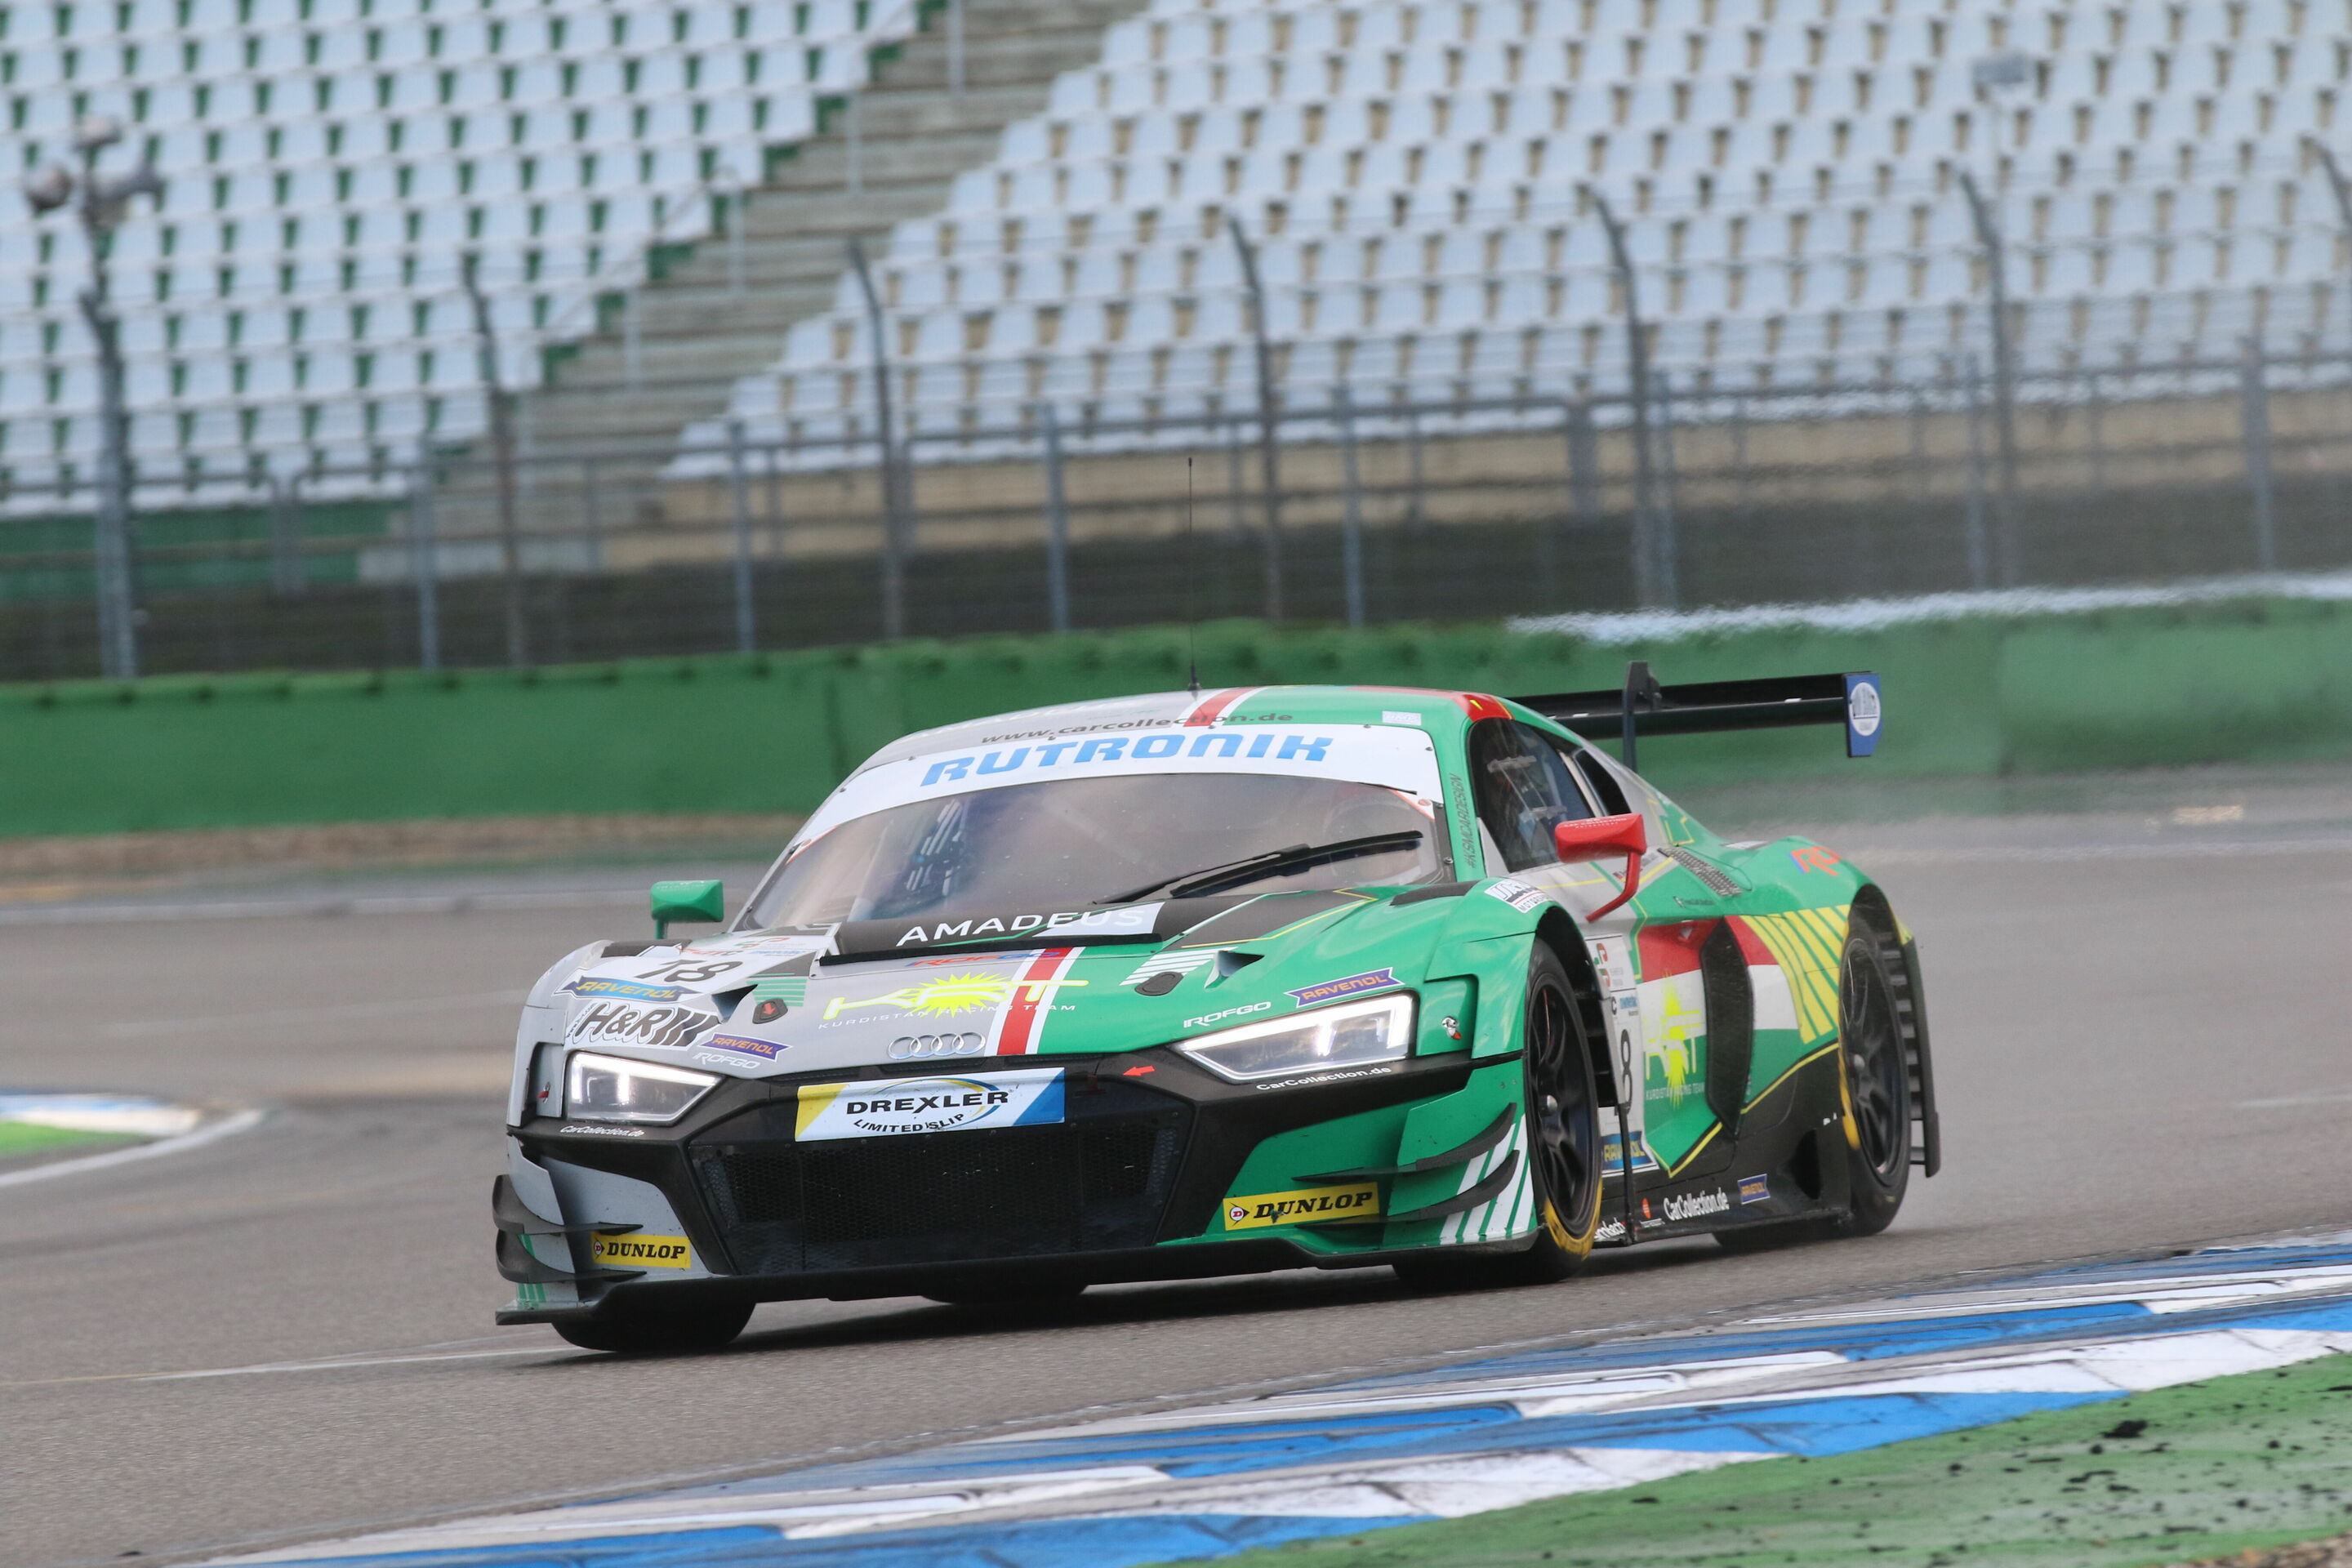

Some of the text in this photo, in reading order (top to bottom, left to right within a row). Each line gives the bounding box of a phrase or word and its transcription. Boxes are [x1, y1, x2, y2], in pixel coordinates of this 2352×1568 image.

[981, 712, 1293, 743] www.carcollection.de
[920, 733, 1333, 786] RUTRONIK
[896, 906, 1146, 947] AMADEUS
[635, 959, 743, 983] 18
[905, 951, 1062, 967] ROFGO
[575, 981, 678, 1000] RAVENOL
[1301, 974, 1388, 1001] RAVENOL
[573, 1002, 675, 1041] H&R
[818, 1009, 932, 1030] KURDISTAN
[941, 1004, 1013, 1015] RACING
[1183, 1001, 1272, 1028] ROFGO
[712, 1036, 775, 1055] RAVENOL
[693, 1052, 761, 1069] ROFGO
[1256, 1066, 1392, 1090] CarCollection.de
[846, 1090, 1009, 1115] DREXLER
[559, 1125, 645, 1138] CarCollection.de
[853, 1113, 964, 1133] LIMITED SLIP
[1253, 1192, 1374, 1219] DUNLOP
[1664, 1187, 1730, 1221] CarCollection.de
[607, 1242, 686, 1259] DUNLOP
